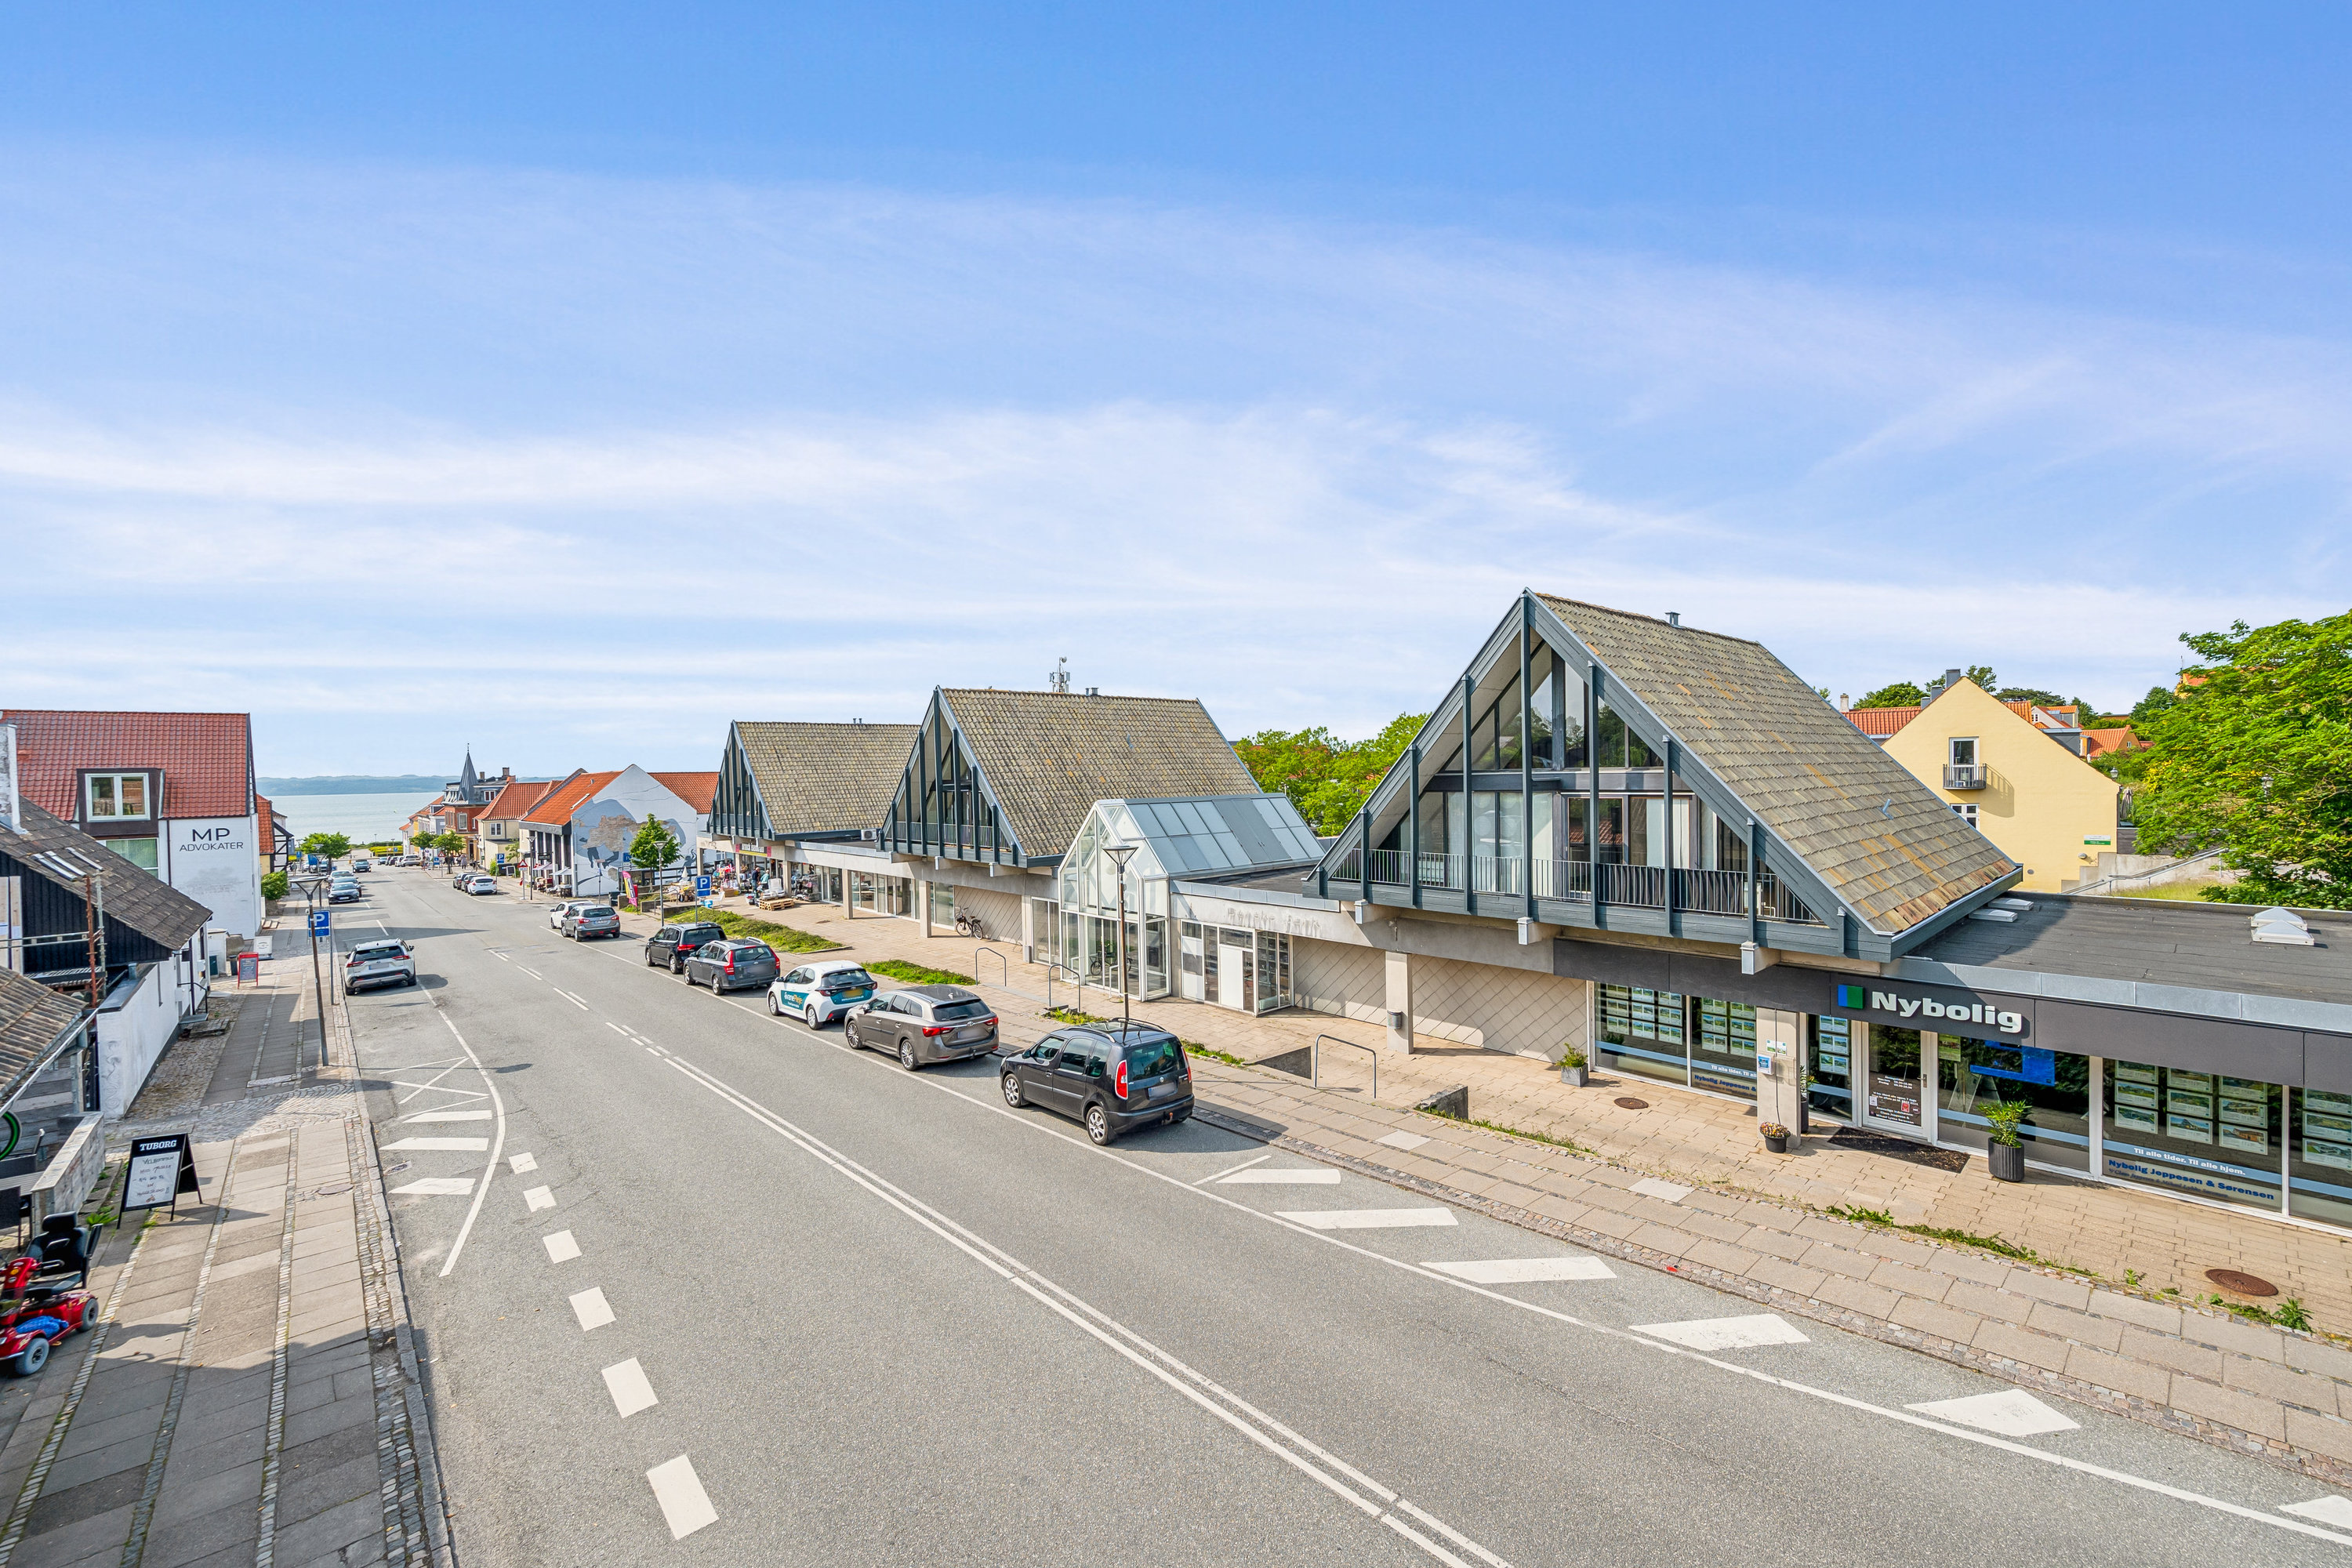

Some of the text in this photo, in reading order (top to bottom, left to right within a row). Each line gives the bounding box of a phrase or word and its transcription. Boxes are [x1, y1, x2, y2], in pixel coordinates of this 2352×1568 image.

[192, 828, 230, 841] MP
[180, 842, 244, 851] ADVOKATER
[700, 878, 708, 888] P
[314, 913, 325, 926] P
[1871, 991, 2022, 1033] Nybolig
[1694, 1075, 1718, 1084] Nybolig
[1719, 1080, 1750, 1091] Jeppesen
[140, 1139, 177, 1151] TUBORG
[2146, 1150, 2162, 1159] alle
[2163, 1152, 2187, 1163] tider.
[2201, 1160, 2218, 1170] alle
[2220, 1164, 2246, 1175] hjem.
[2108, 1159, 2274, 1200] Nybolig Jeppesen & Sørensen
